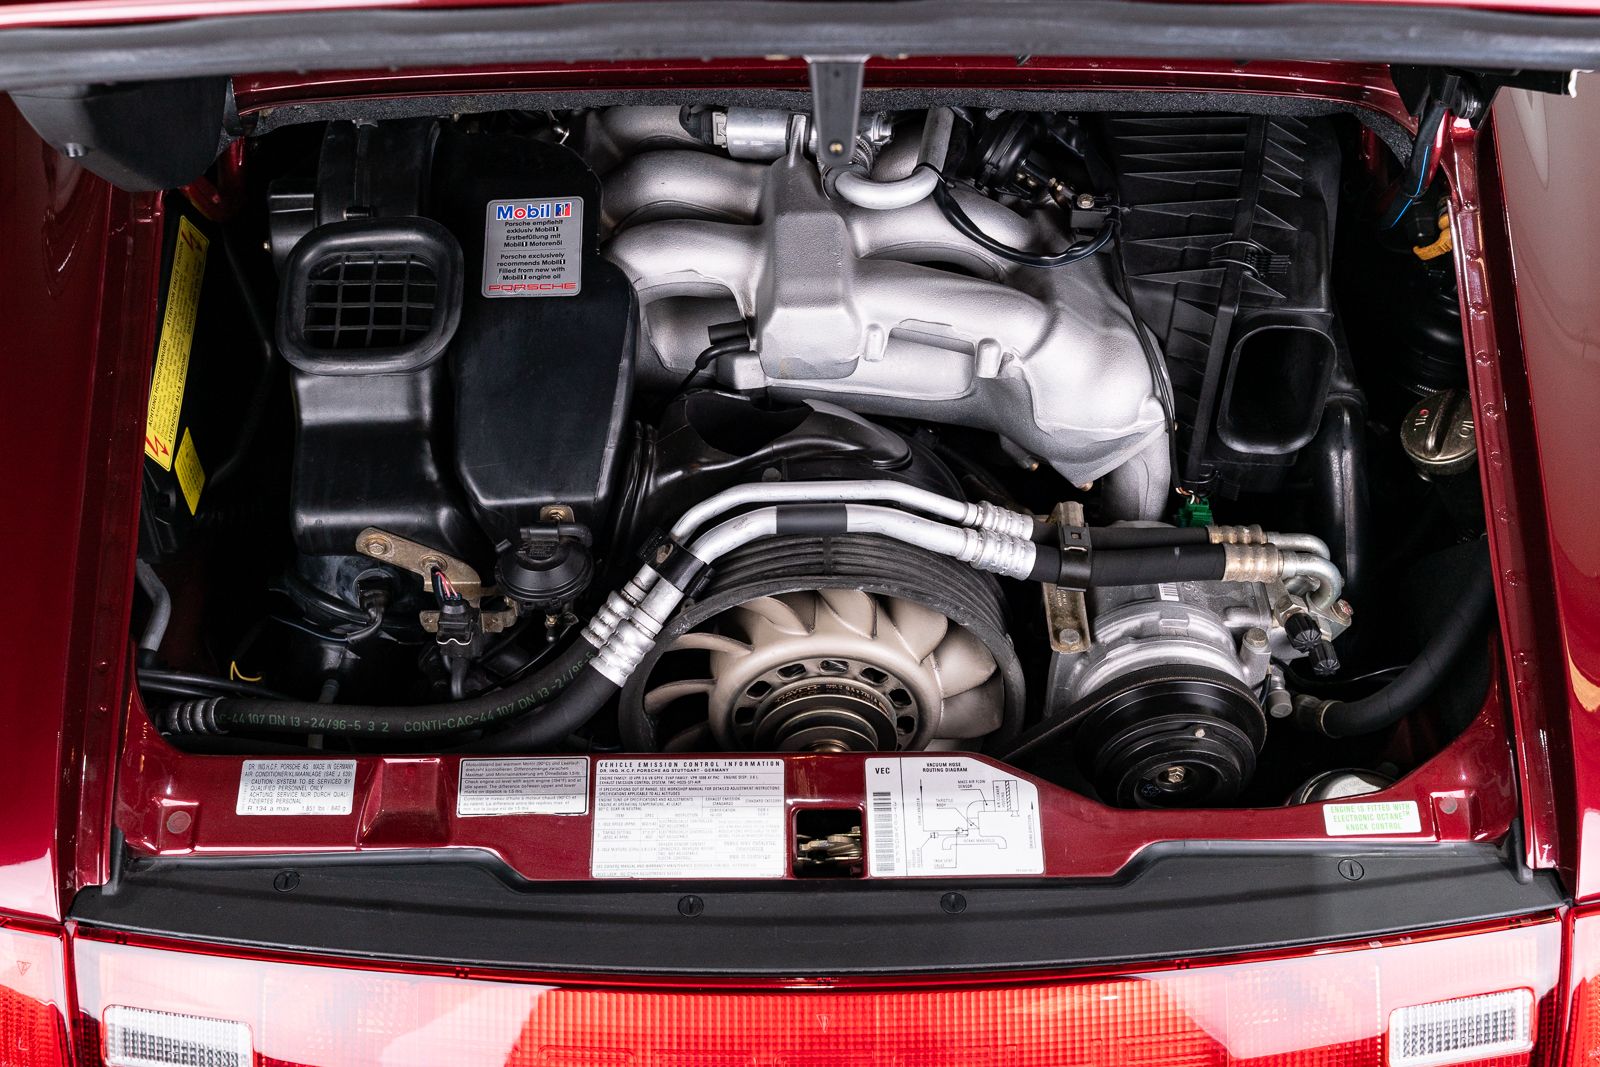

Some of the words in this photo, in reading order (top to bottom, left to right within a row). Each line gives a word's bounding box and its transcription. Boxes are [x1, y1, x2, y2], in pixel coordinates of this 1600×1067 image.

[497, 203, 551, 220] Mobil
[488, 282, 576, 291] PORSCHE
[148, 394, 157, 426] ACHTUNG
[154, 339, 168, 393] HOCHSPANNUNG
[168, 405, 178, 443] ATTENZIONE
[290, 716, 300, 726] 13
[367, 720, 374, 730] 3
[381, 721, 388, 732] 2
[1333, 814, 1373, 822] ELECTRONIC
